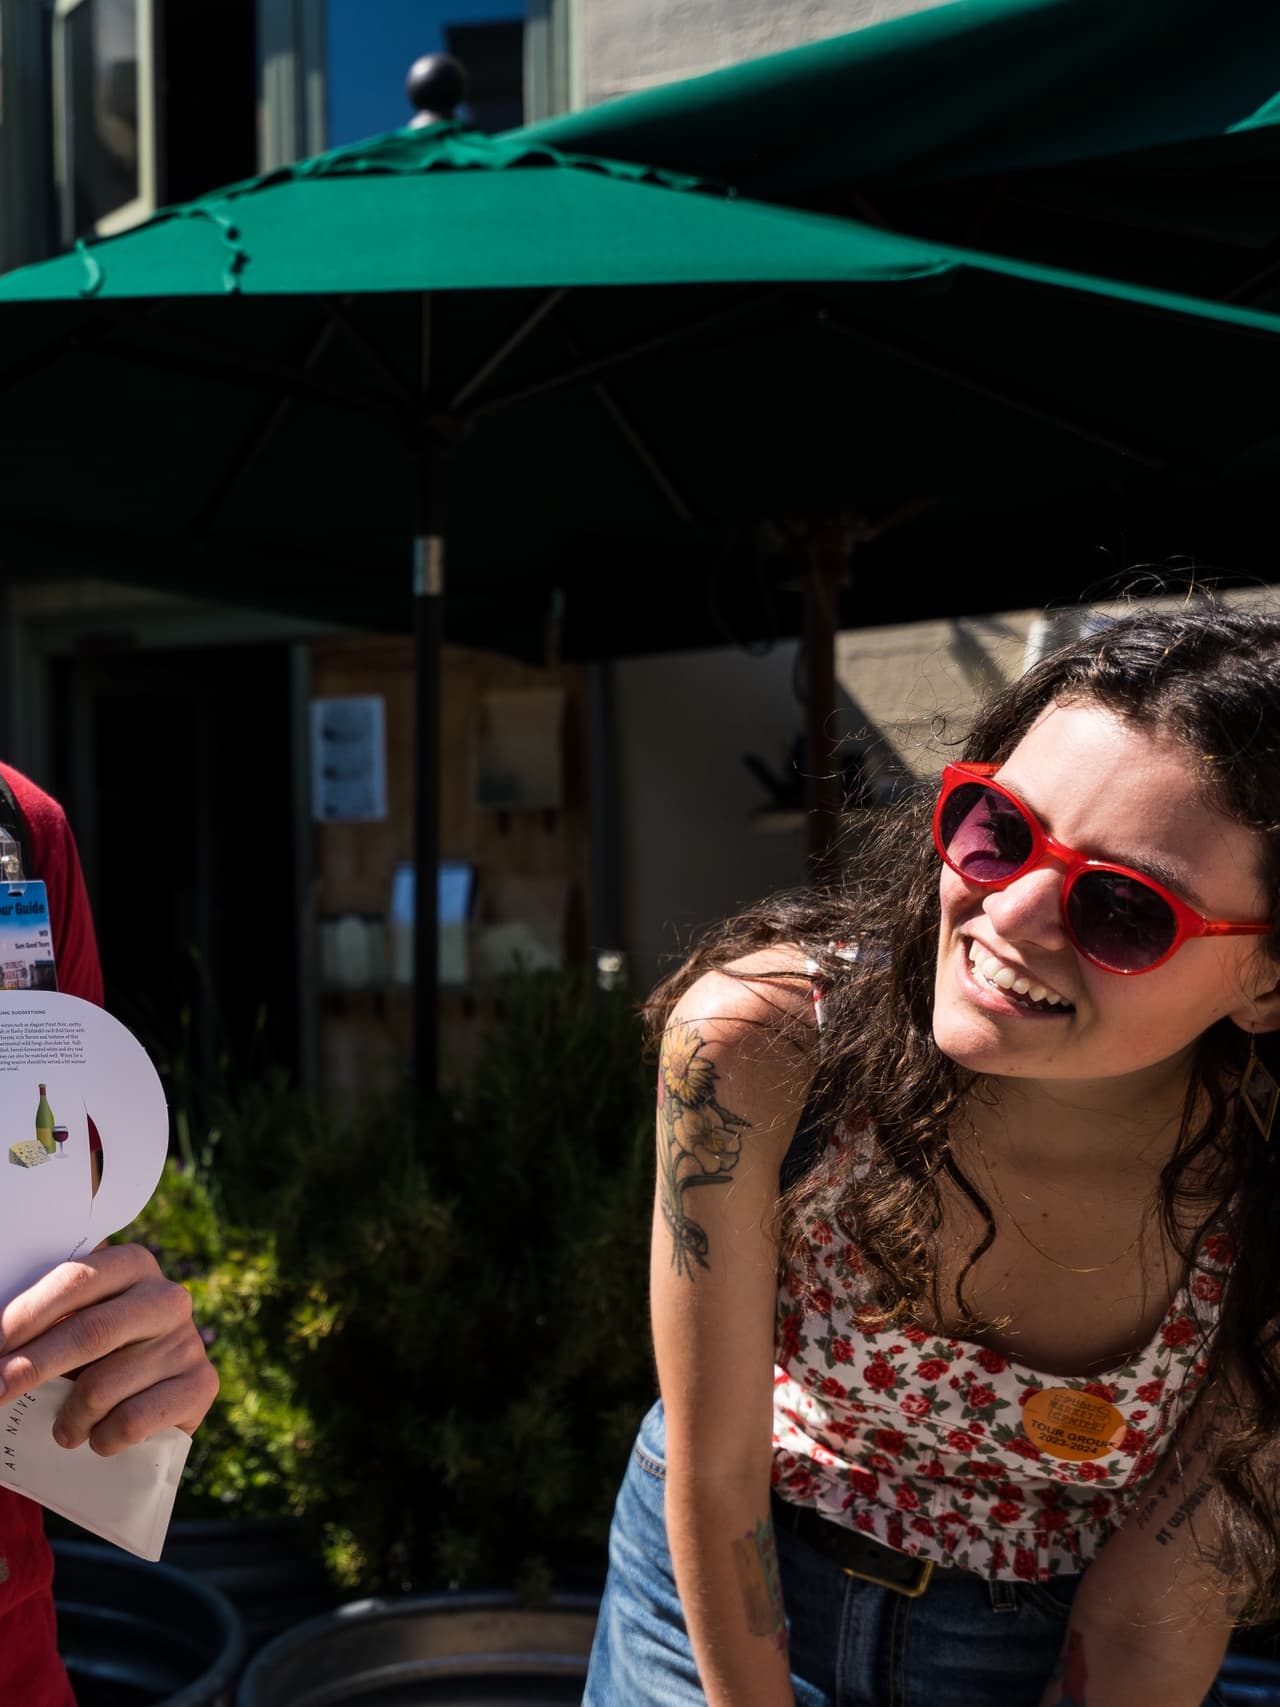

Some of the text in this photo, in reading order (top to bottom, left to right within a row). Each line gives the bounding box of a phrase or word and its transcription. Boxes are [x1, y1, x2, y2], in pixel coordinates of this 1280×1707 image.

[15, 902, 45, 915] Guide
[5, 1392, 36, 1436] NAIVE
[1031, 1419, 1116, 1448] TOUR GROUP
[1039, 1432, 1098, 1454] 2023-2024
